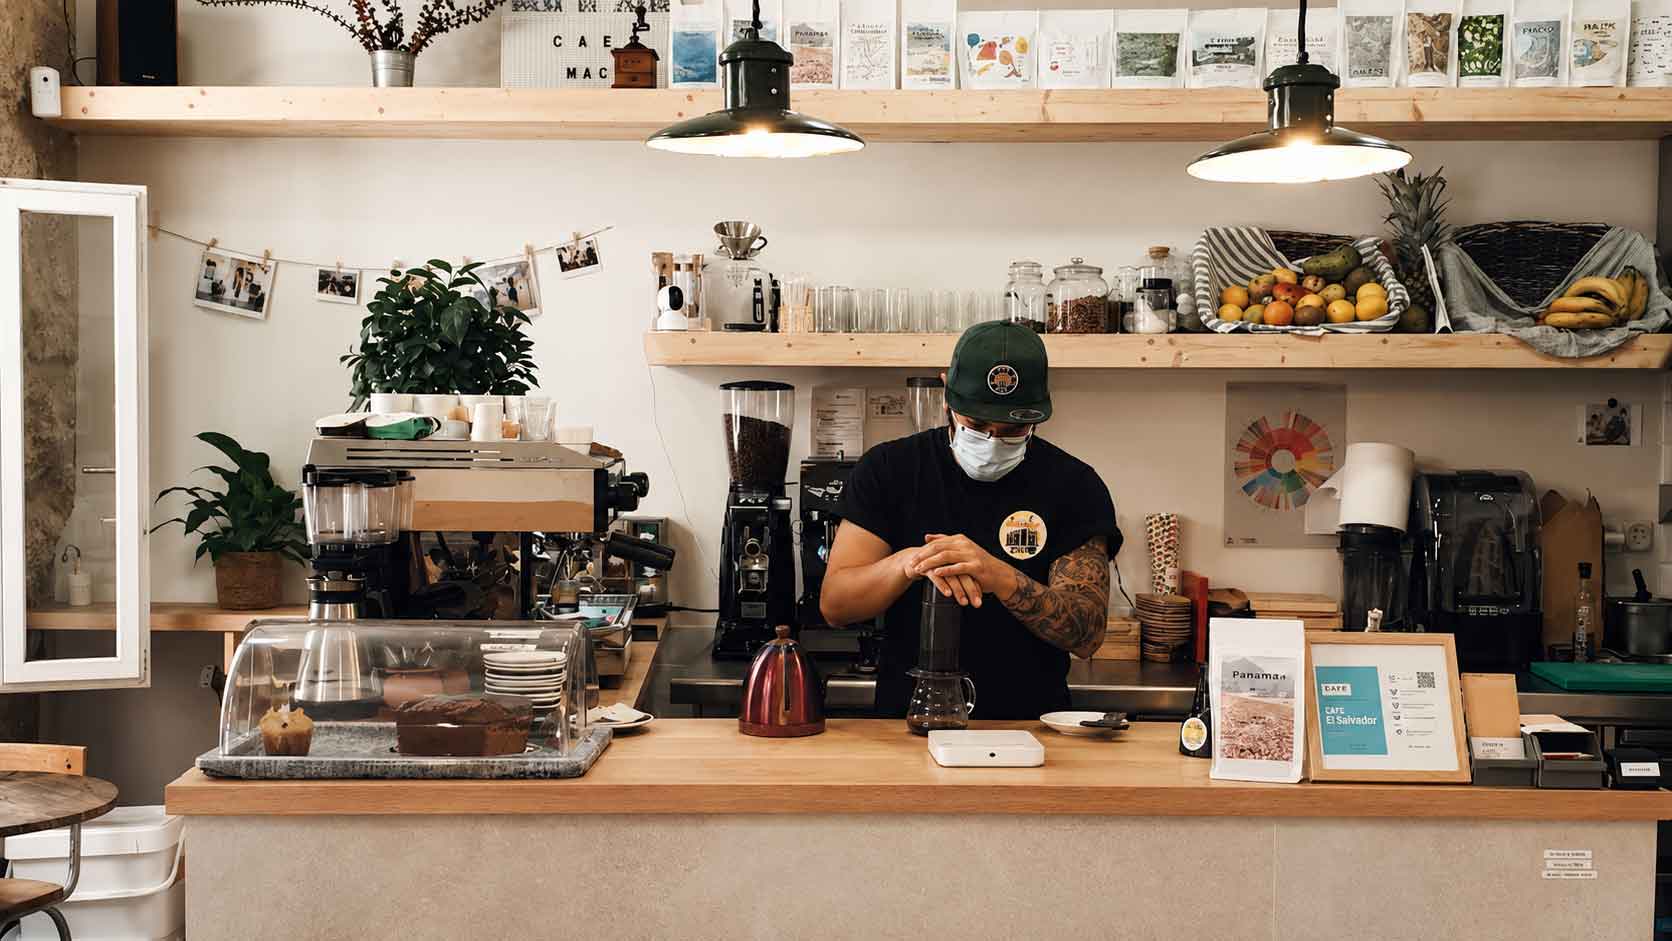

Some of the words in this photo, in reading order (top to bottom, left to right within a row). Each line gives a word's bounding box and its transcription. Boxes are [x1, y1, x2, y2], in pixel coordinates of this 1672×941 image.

[566, 67, 608, 79] MAC
[1325, 707, 1345, 715] CAFE
[1326, 715, 1335, 725] El
[1336, 714, 1378, 725] Salvador
